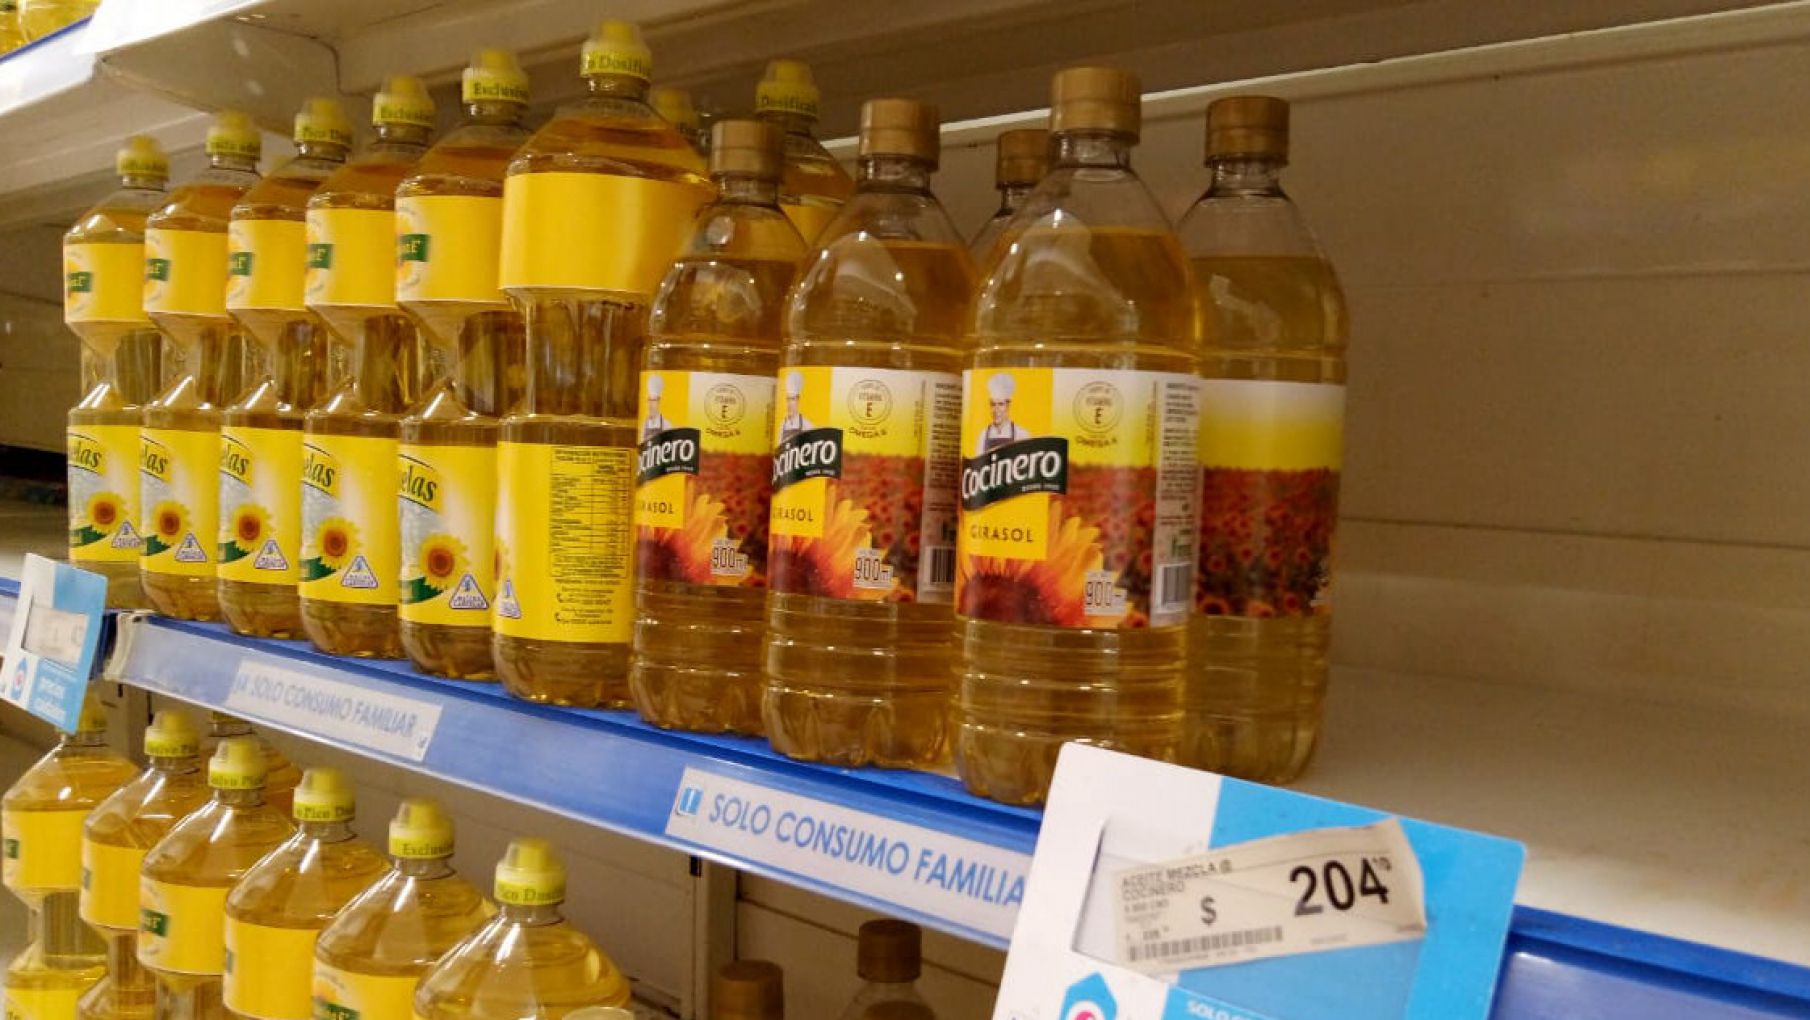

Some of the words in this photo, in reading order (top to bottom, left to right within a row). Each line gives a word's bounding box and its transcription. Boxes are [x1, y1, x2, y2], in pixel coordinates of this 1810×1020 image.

[399, 464, 437, 502] elas
[961, 450, 1062, 500] Cocinero
[971, 523, 1035, 543] GIRASOL
[251, 673, 284, 704] SOLO
[284, 684, 353, 721] CONSUMO
[352, 703, 418, 736] FAMILIAR
[709, 793, 771, 836] SOLO
[775, 811, 909, 876] CONSUMO
[913, 847, 1025, 906] FAMILIA
[1166, 862, 1216, 879] MEZCLA
[1289, 857, 1389, 916] 204
[1122, 879, 1185, 901] COCINERO
[1200, 895, 1217, 926] $
